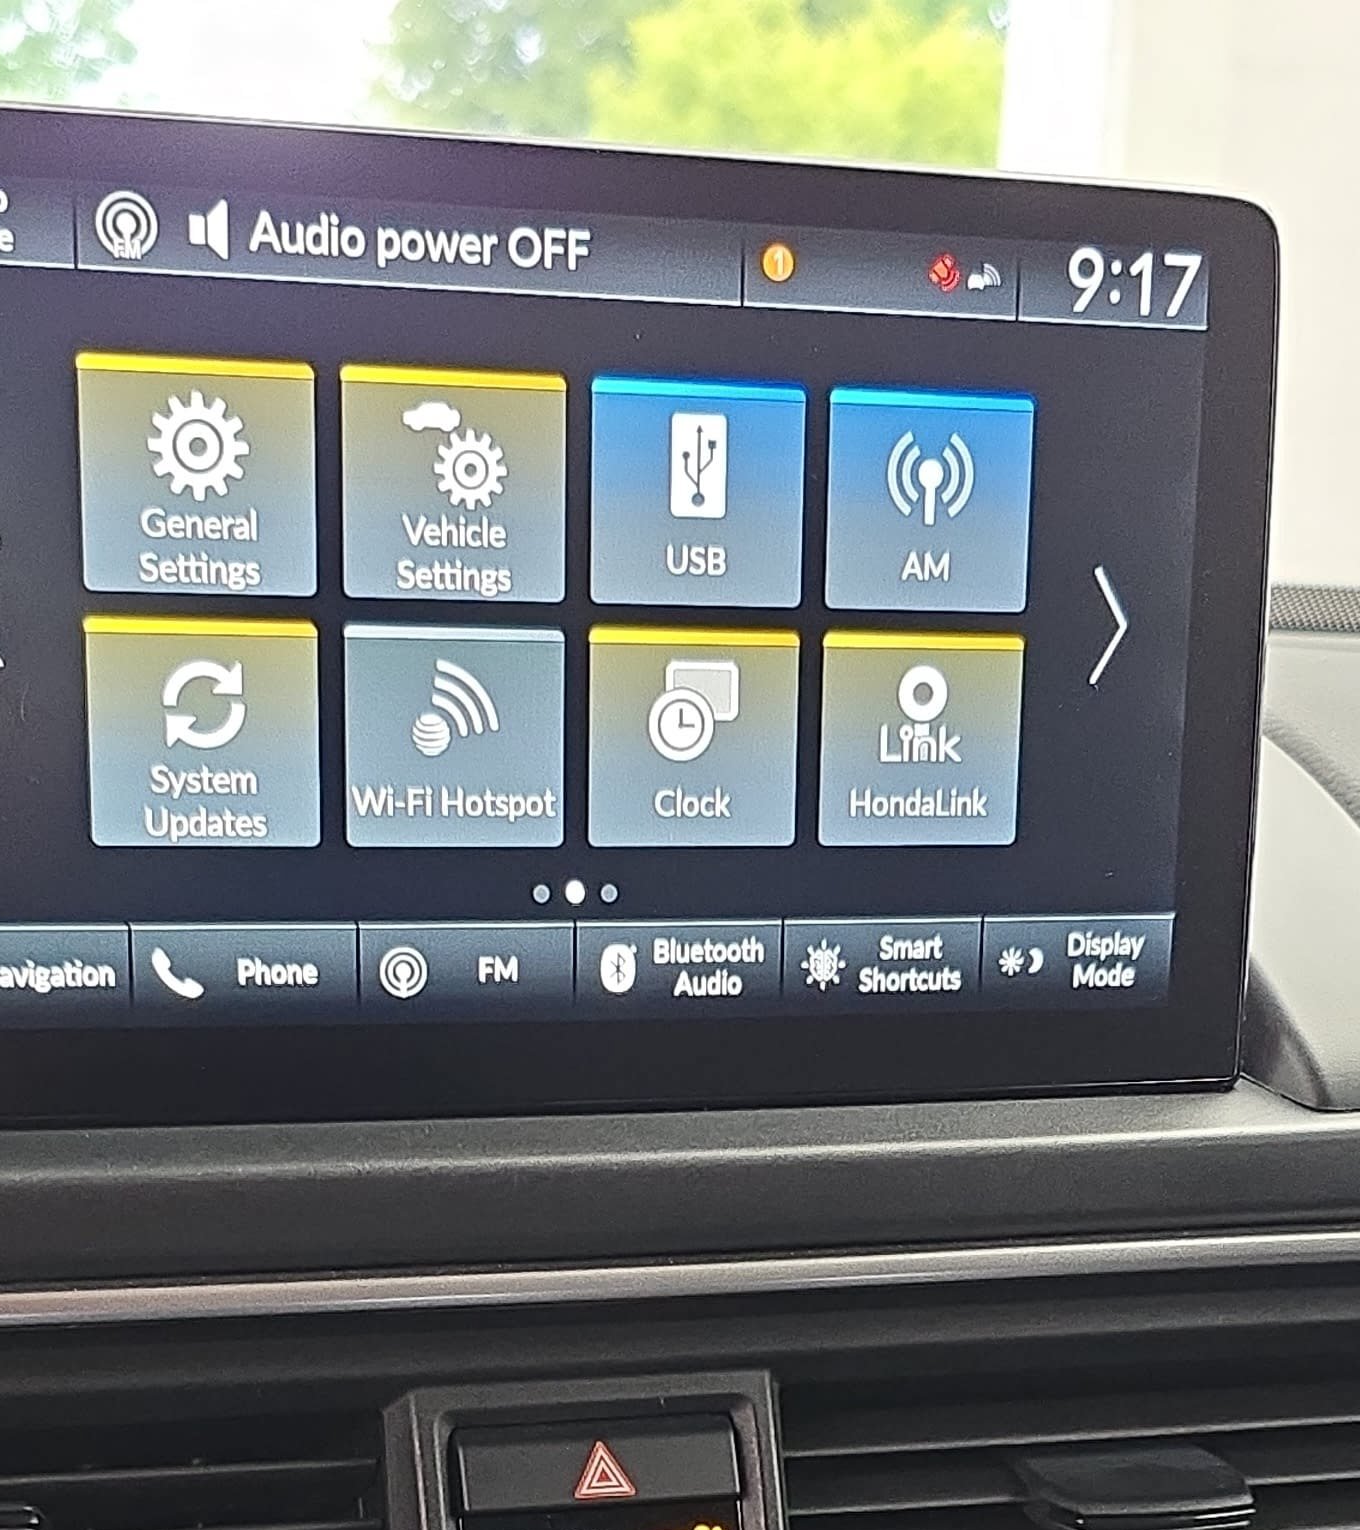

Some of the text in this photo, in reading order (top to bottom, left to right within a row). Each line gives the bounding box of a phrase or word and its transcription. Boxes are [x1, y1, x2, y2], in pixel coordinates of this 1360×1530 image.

[249, 211, 592, 270] Audio power OFF
[1068, 247, 1202, 316] 9:17
[140, 507, 258, 542] General
[401, 514, 507, 549] Vehicle
[139, 553, 261, 588] Settings
[666, 544, 727, 578] USB
[901, 553, 951, 582] AM
[396, 560, 512, 596] Settings
[150, 765, 258, 799] System
[352, 786, 556, 821] Wi-Fi Hotspot
[654, 788, 731, 818] Clock
[849, 787, 987, 817] HondaLink
[144, 807, 268, 841] Updates
[653, 937, 765, 966] Bluetooth
[878, 936, 942, 960] Smart
[1067, 932, 1144, 960] Display
[237, 956, 319, 986] Phone
[478, 957, 519, 984] FM
[673, 970, 742, 999] Audio
[858, 967, 962, 994] Shortcuts
[1072, 963, 1135, 988] Mode
